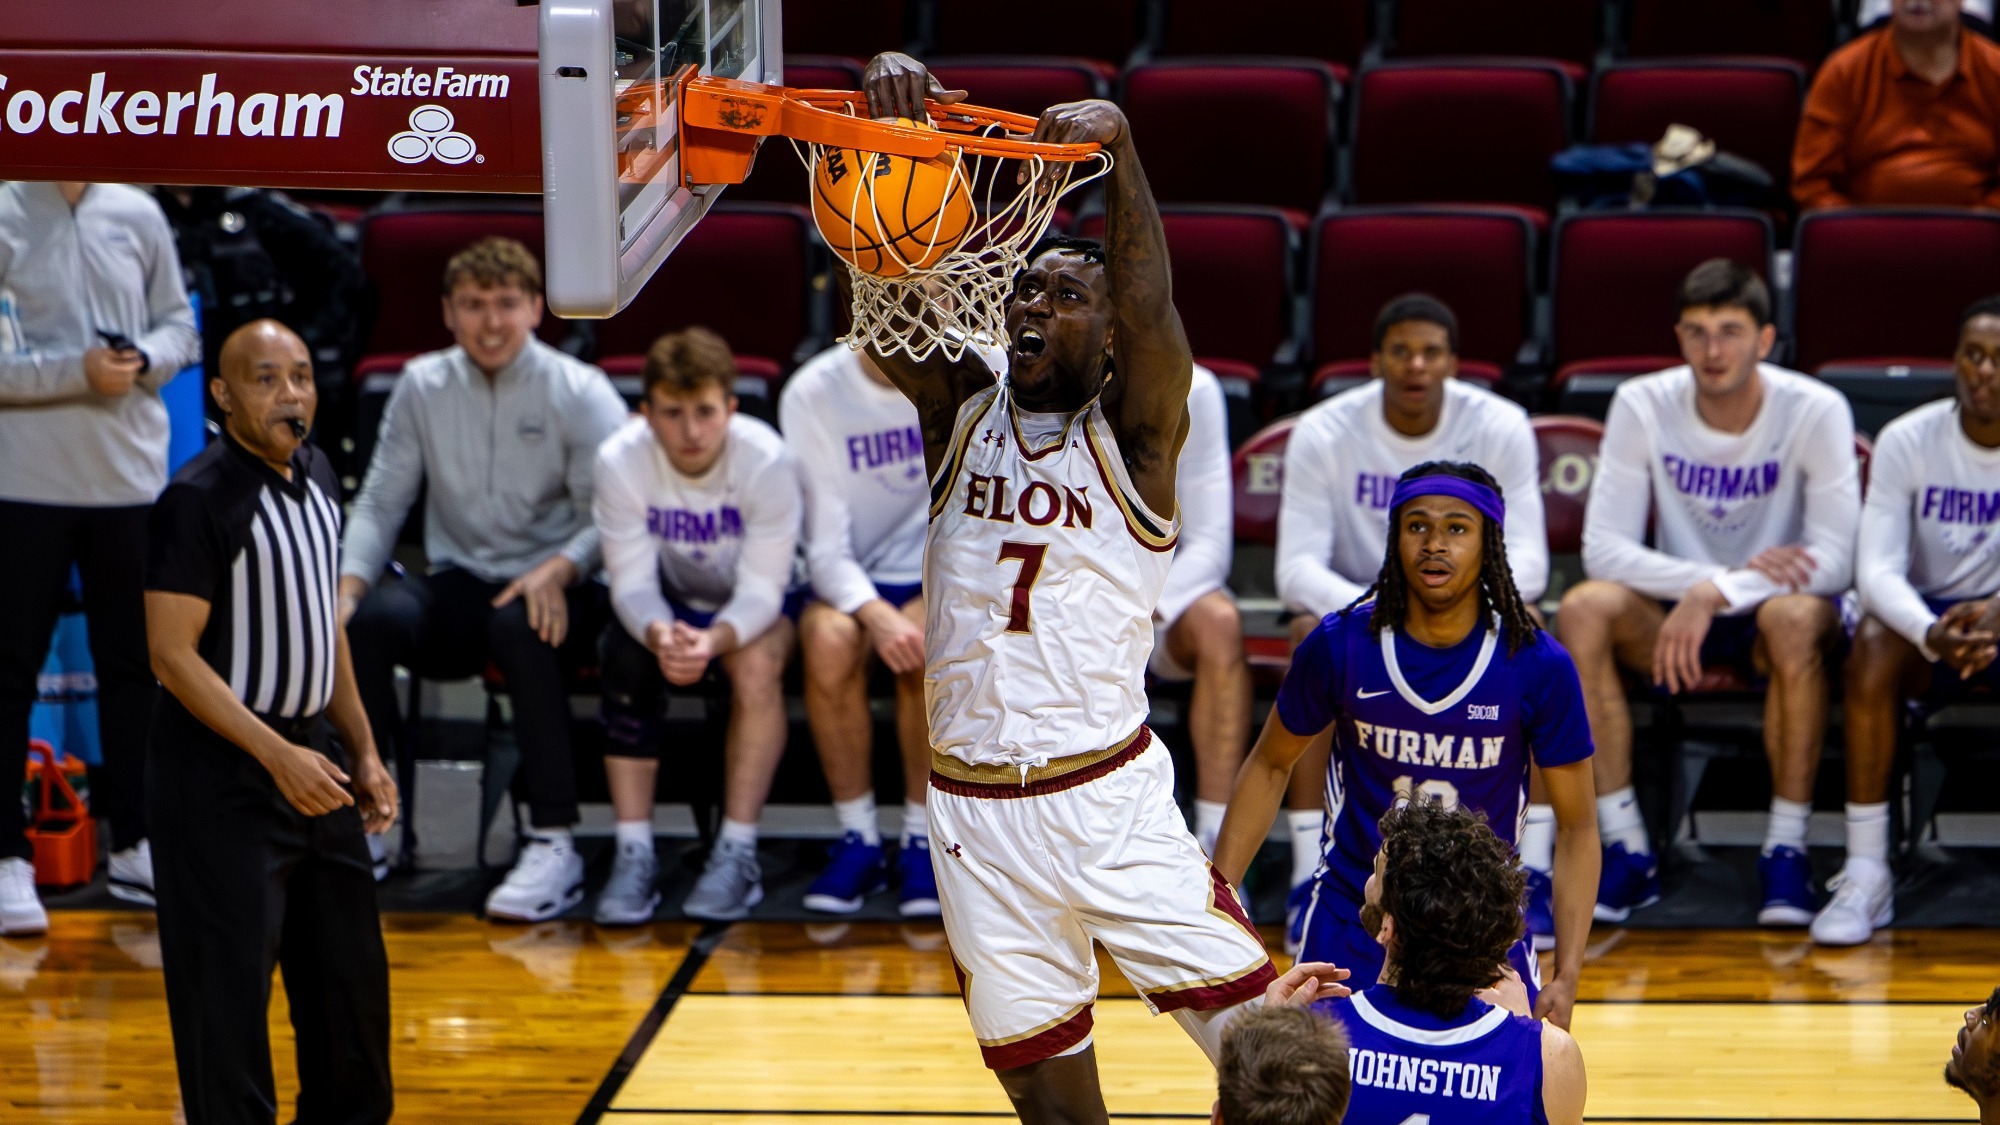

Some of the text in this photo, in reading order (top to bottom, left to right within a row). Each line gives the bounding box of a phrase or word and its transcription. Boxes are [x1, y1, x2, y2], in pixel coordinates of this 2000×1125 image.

[0, 72, 344, 138] ockerham
[962, 472, 1094, 530] ELON
[996, 539, 1050, 635] 7
[1354, 719, 1505, 770] FURMAN
[1348, 1047, 1502, 1101] JOHNSTON
